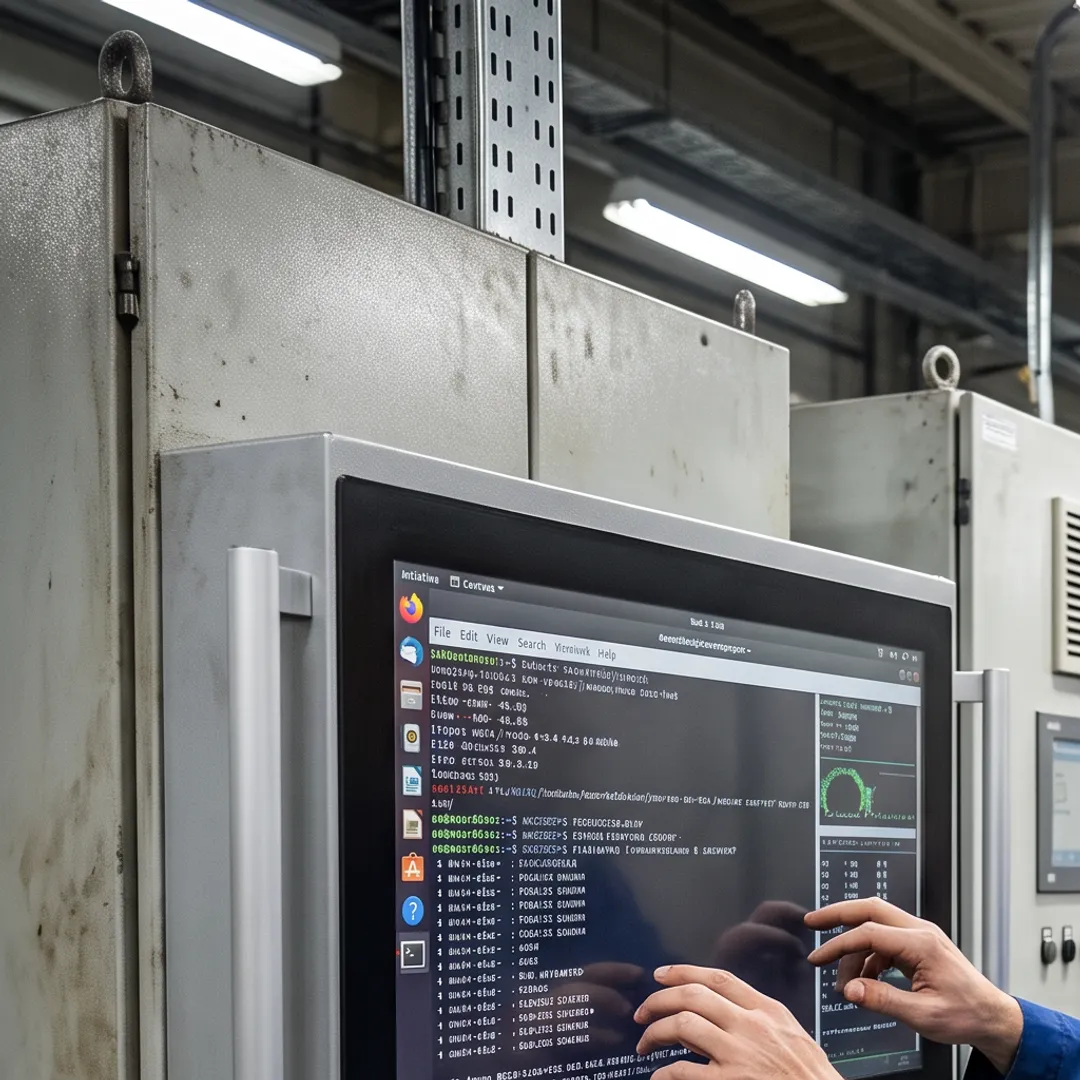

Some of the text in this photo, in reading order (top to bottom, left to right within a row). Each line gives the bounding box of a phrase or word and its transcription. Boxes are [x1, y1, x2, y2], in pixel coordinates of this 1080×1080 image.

[434, 626, 451, 639] File
[460, 630, 478, 643] Edit
[487, 633, 509, 646] View
[517, 638, 547, 651] Search
[598, 648, 616, 661] Help
